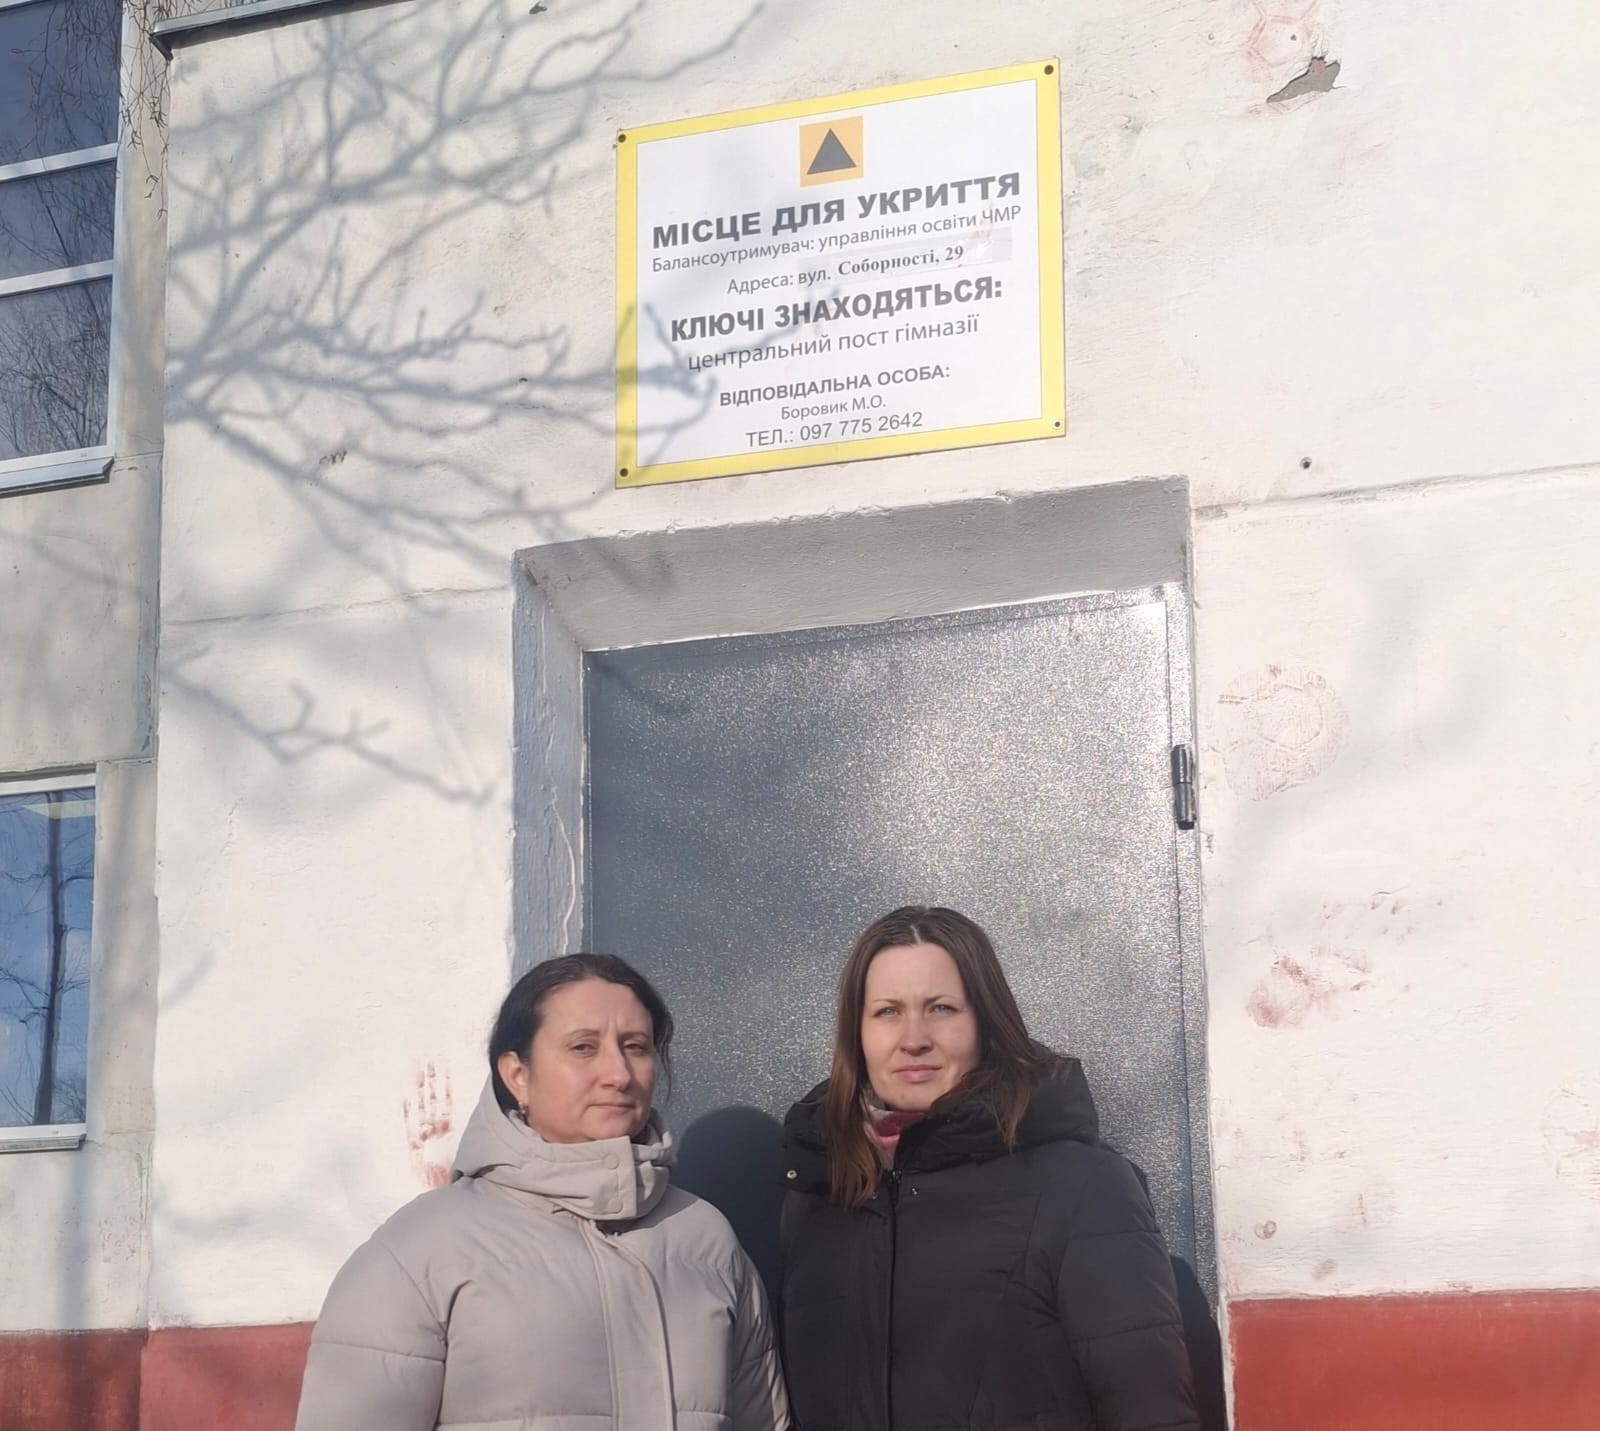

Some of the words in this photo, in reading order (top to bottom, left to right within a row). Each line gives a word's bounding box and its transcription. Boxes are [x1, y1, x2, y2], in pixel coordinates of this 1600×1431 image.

[652, 211, 761, 249] МІСЦЕ
[772, 199, 846, 235] ДЛЯ
[858, 172, 1020, 218] УКРИТТЯ
[652, 239, 814, 272] Балансоутримувач:
[819, 224, 917, 248] управління
[922, 214, 976, 233] освіти
[982, 206, 1021, 224] ЧМР
[727, 272, 794, 294] Адреса:
[798, 267, 831, 287] вул.
[838, 250, 939, 273] Соборності,
[945, 245, 964, 262] 29
[671, 309, 765, 341] КЛЮЧІ
[775, 276, 1002, 328] ЗНАХОДЯТЬСЯ:
[688, 334, 831, 372] центральний
[838, 330, 887, 350] пост
[895, 314, 980, 342] гімназії
[720, 374, 871, 407] ВІДПОВІДАЛЬНА
[877, 364, 950, 386] ОСОБА:
[781, 401, 848, 420] Боровик
[852, 395, 886, 410] М.О.
[746, 429, 794, 447] ТЕЛ.:
[800, 423, 832, 442] 097
[840, 418, 871, 437] 775
[878, 411, 923, 433] 2642
